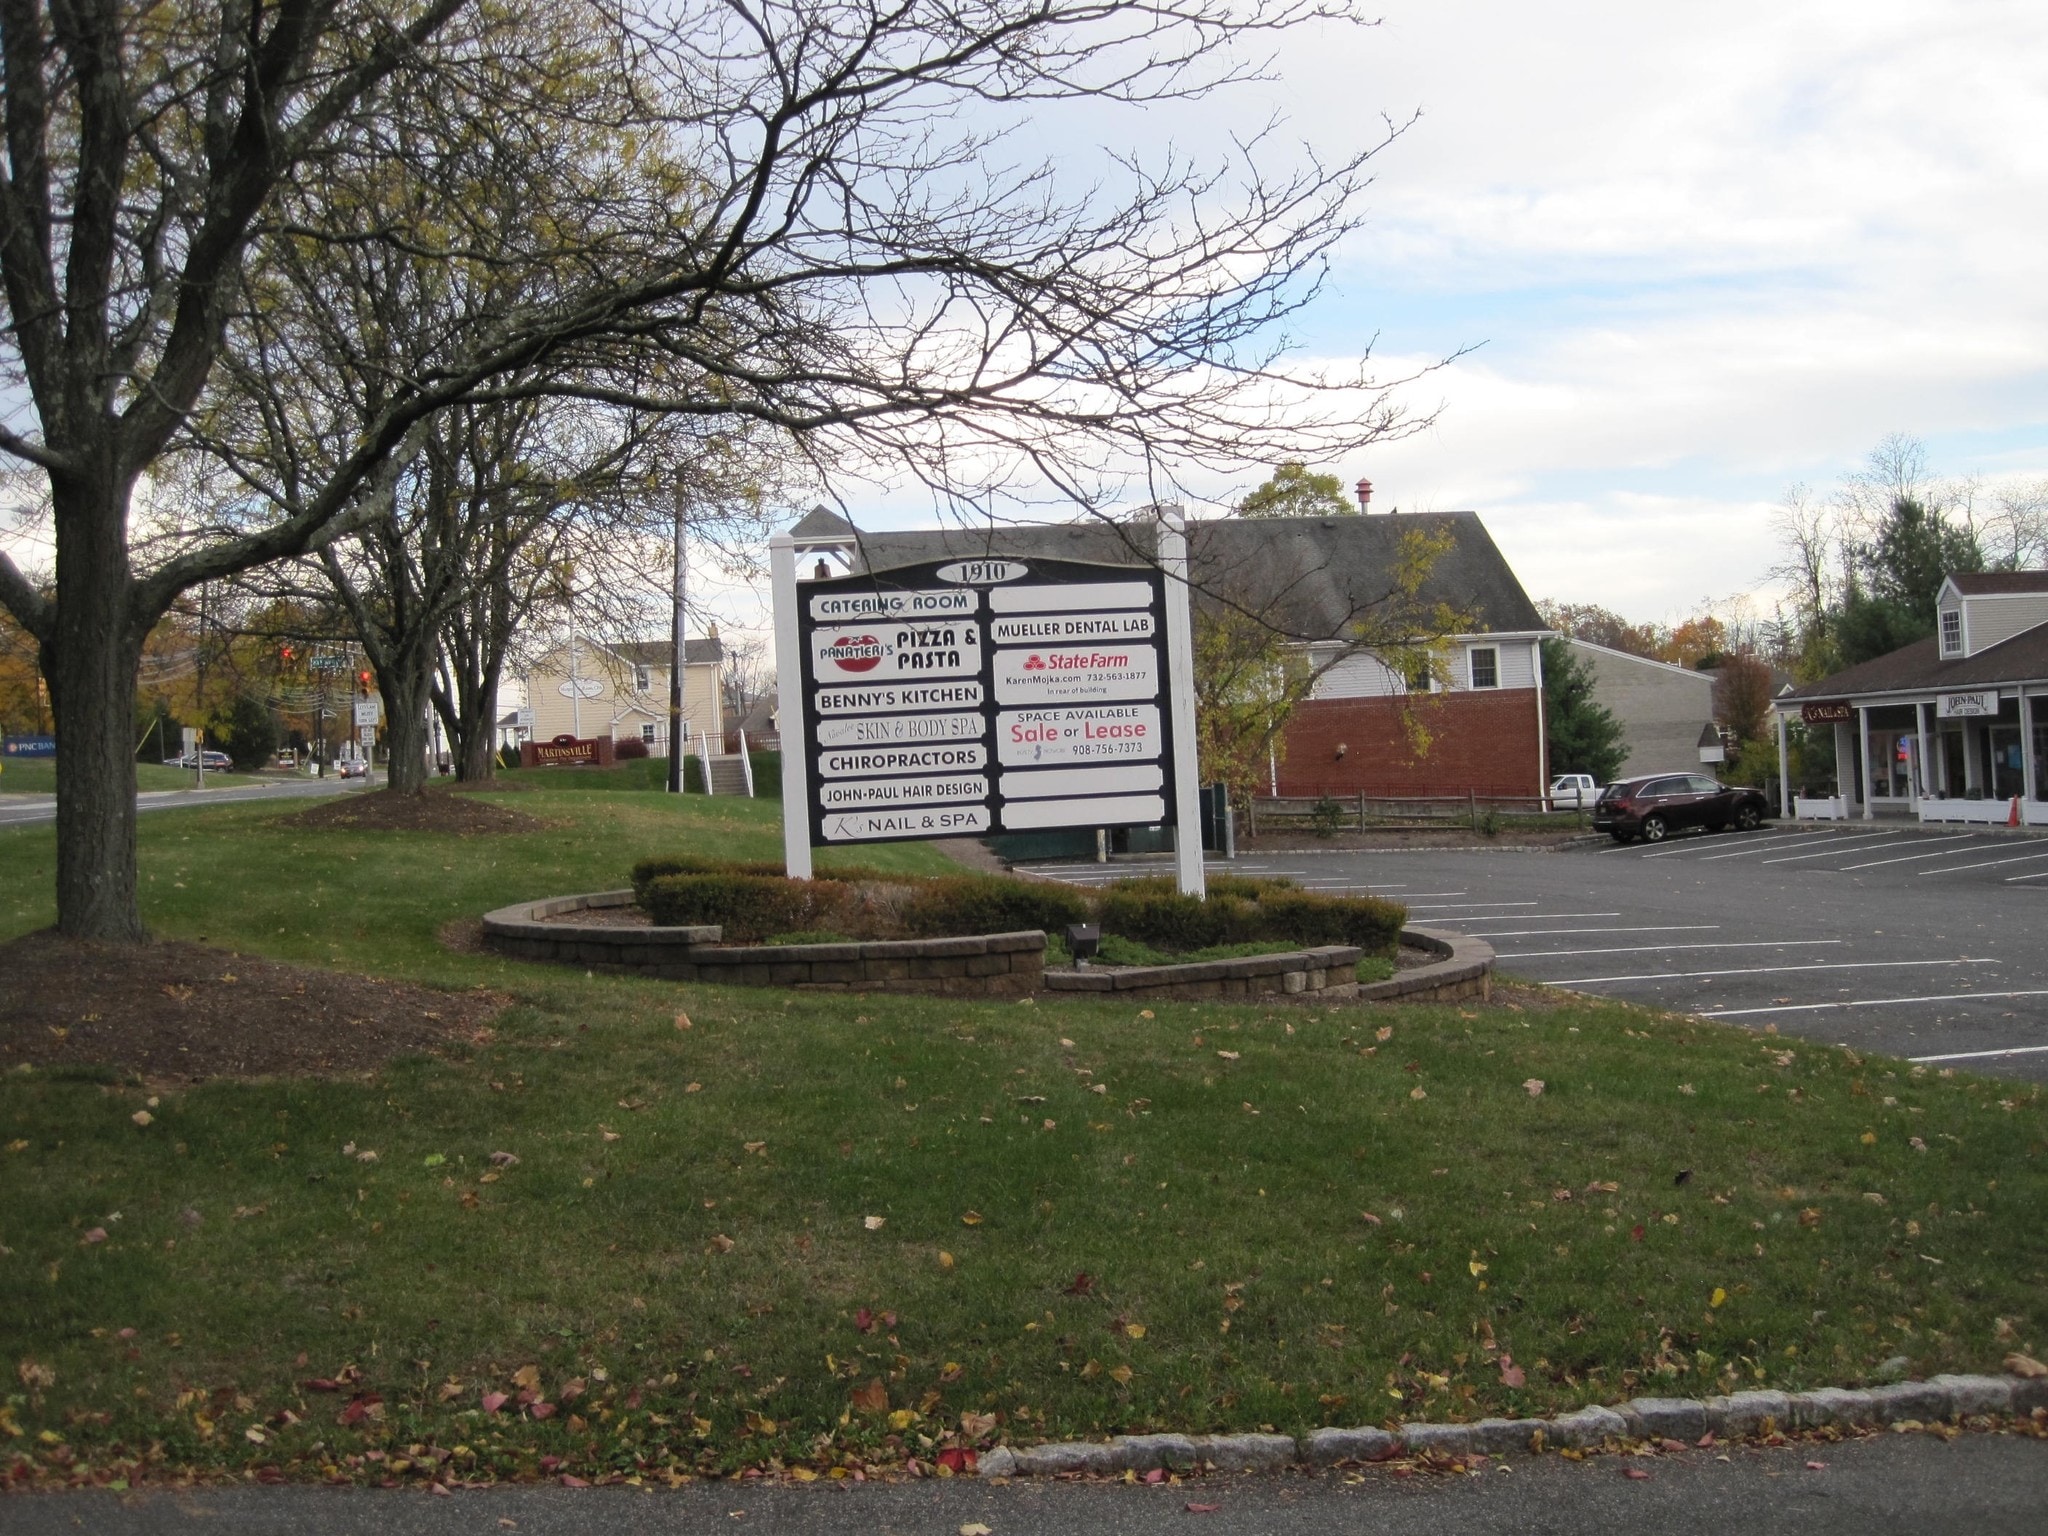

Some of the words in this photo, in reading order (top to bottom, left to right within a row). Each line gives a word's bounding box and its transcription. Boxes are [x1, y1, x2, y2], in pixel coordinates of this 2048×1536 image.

[960, 564, 1006, 581] 1910
[820, 596, 901, 614] CATERING
[913, 595, 968, 610] ROOM
[997, 622, 1060, 638] MUELLER
[1065, 620, 1119, 635] DENTAL
[1123, 618, 1150, 632] LAB
[896, 629, 956, 649] PIZZA
[964, 628, 978, 645] &
[820, 643, 894, 660] PANATIERI'S
[898, 650, 960, 670] PASTA
[1006, 674, 1082, 686] KarenMojka.com
[1086, 671, 1147, 682] 732-563-1877
[821, 691, 896, 709] BENNY'S
[902, 687, 978, 704] KITCHEN
[1079, 685, 1107, 694] building
[1017, 711, 1061, 723] SPACE
[1065, 707, 1139, 721] AVAILABLE
[856, 721, 891, 741] SKIN
[894, 720, 904, 738] &
[908, 719, 948, 738] BODY
[951, 717, 978, 736] SPA
[1011, 722, 1059, 743] Sale
[1063, 727, 1080, 738] or
[1084, 721, 1147, 740] Lease
[19, 743, 37, 751] PNC
[38, 742, 56, 750] BAN
[537, 743, 592, 758] MARTINSVILLE
[1072, 741, 1143, 755] 908-756-7373
[829, 749, 977, 771] CHIROPRACTORS
[903, 784, 933, 798] HAIR
[936, 782, 983, 796] DESIGN
[834, 815, 864, 838] K's
[868, 817, 916, 832] NAIL
[921, 815, 935, 829] &
[940, 813, 978, 827] SPA
